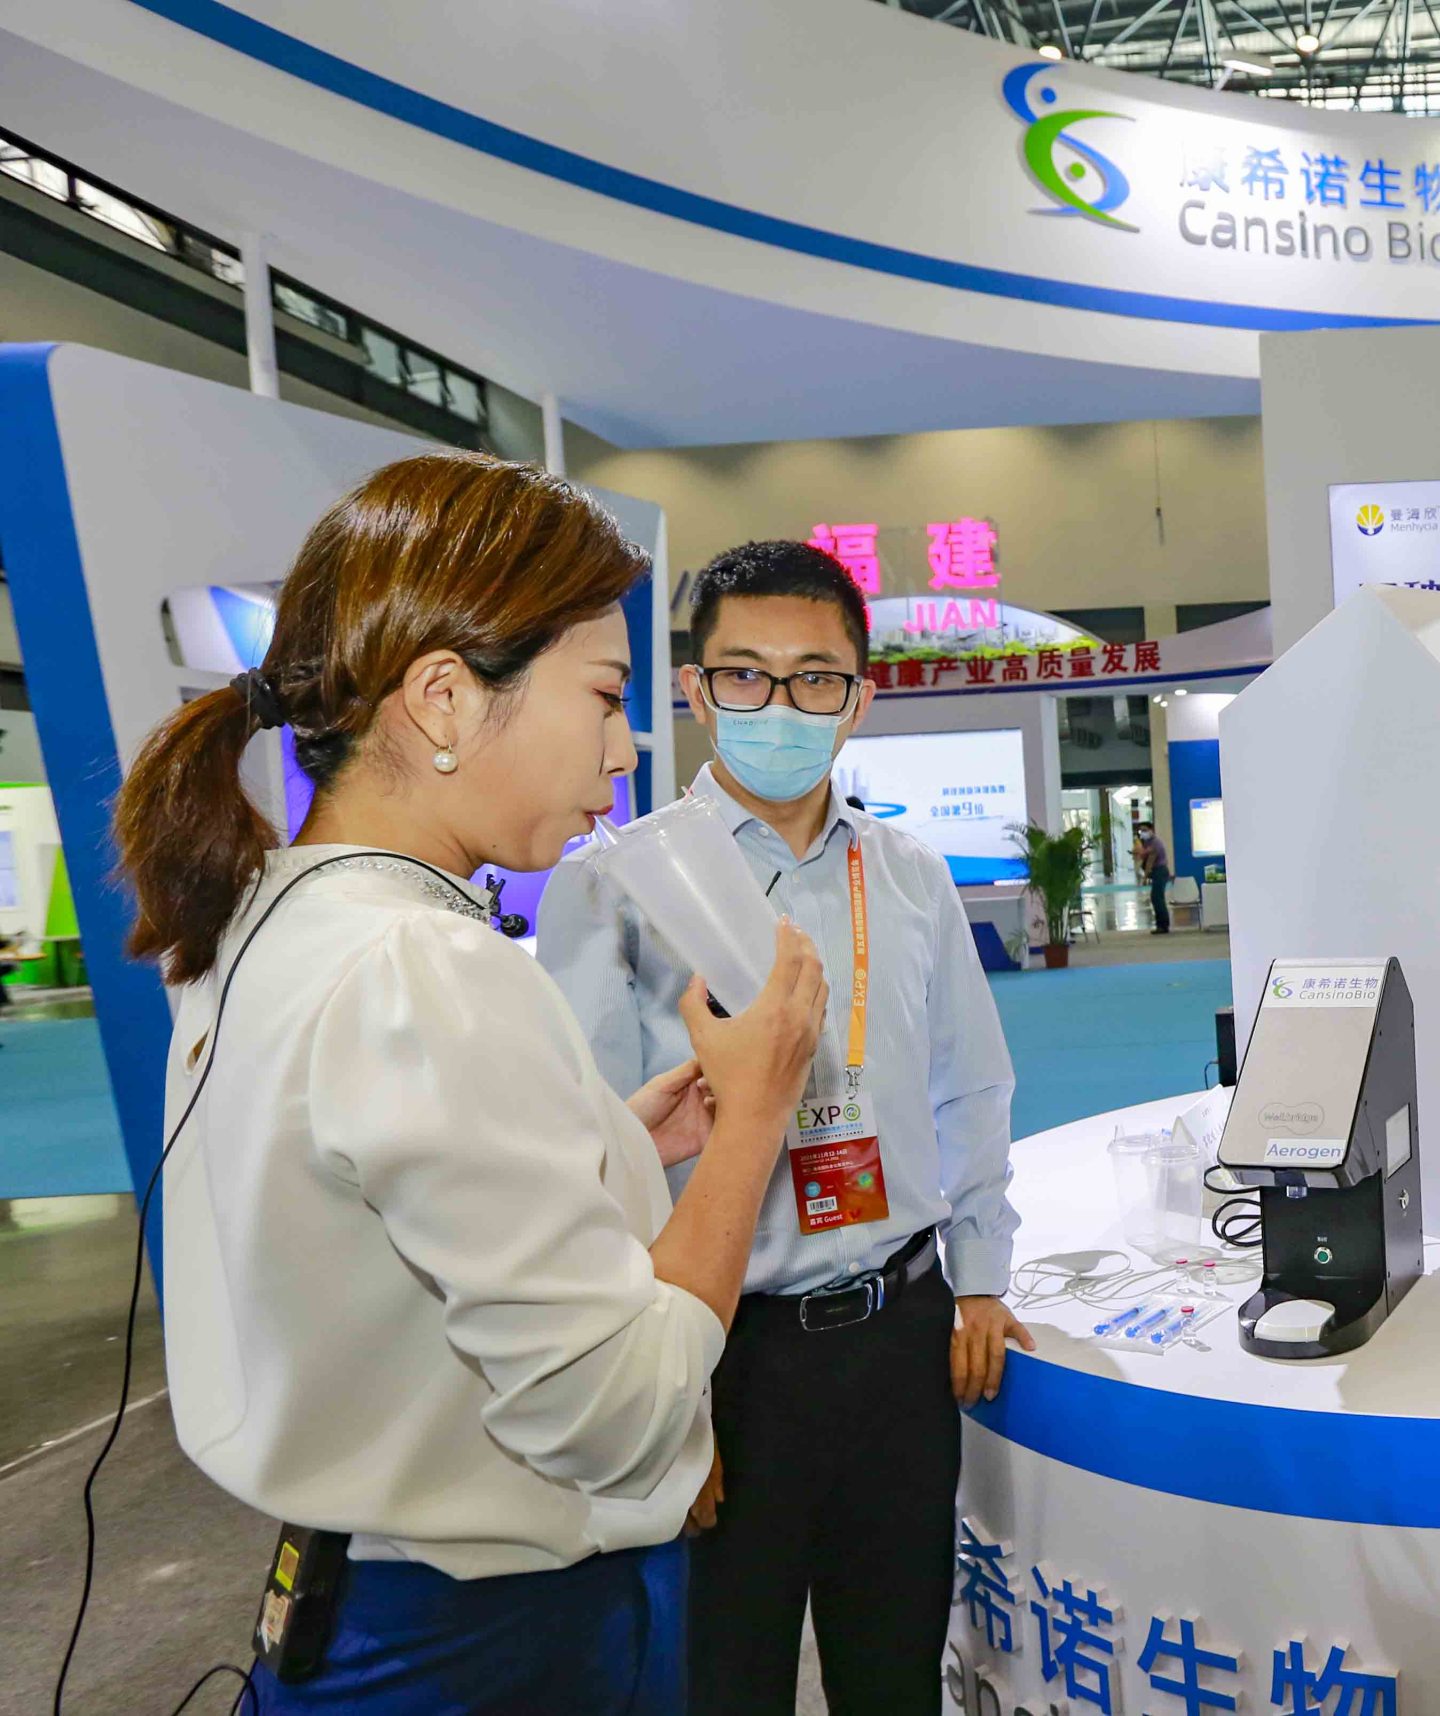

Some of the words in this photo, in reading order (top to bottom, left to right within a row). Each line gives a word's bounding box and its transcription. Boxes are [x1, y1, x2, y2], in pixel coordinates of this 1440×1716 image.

[1179, 198, 1370, 262] Cansino
[1391, 522, 1438, 533] Menhycia
[904, 598, 998, 633] JIAN
[1302, 978, 1379, 989] 康希诺生物
[1300, 990, 1376, 1000] CansinoBio
[1266, 1144, 1341, 1159] Aerogen
[824, 1214, 843, 1222] Guest
